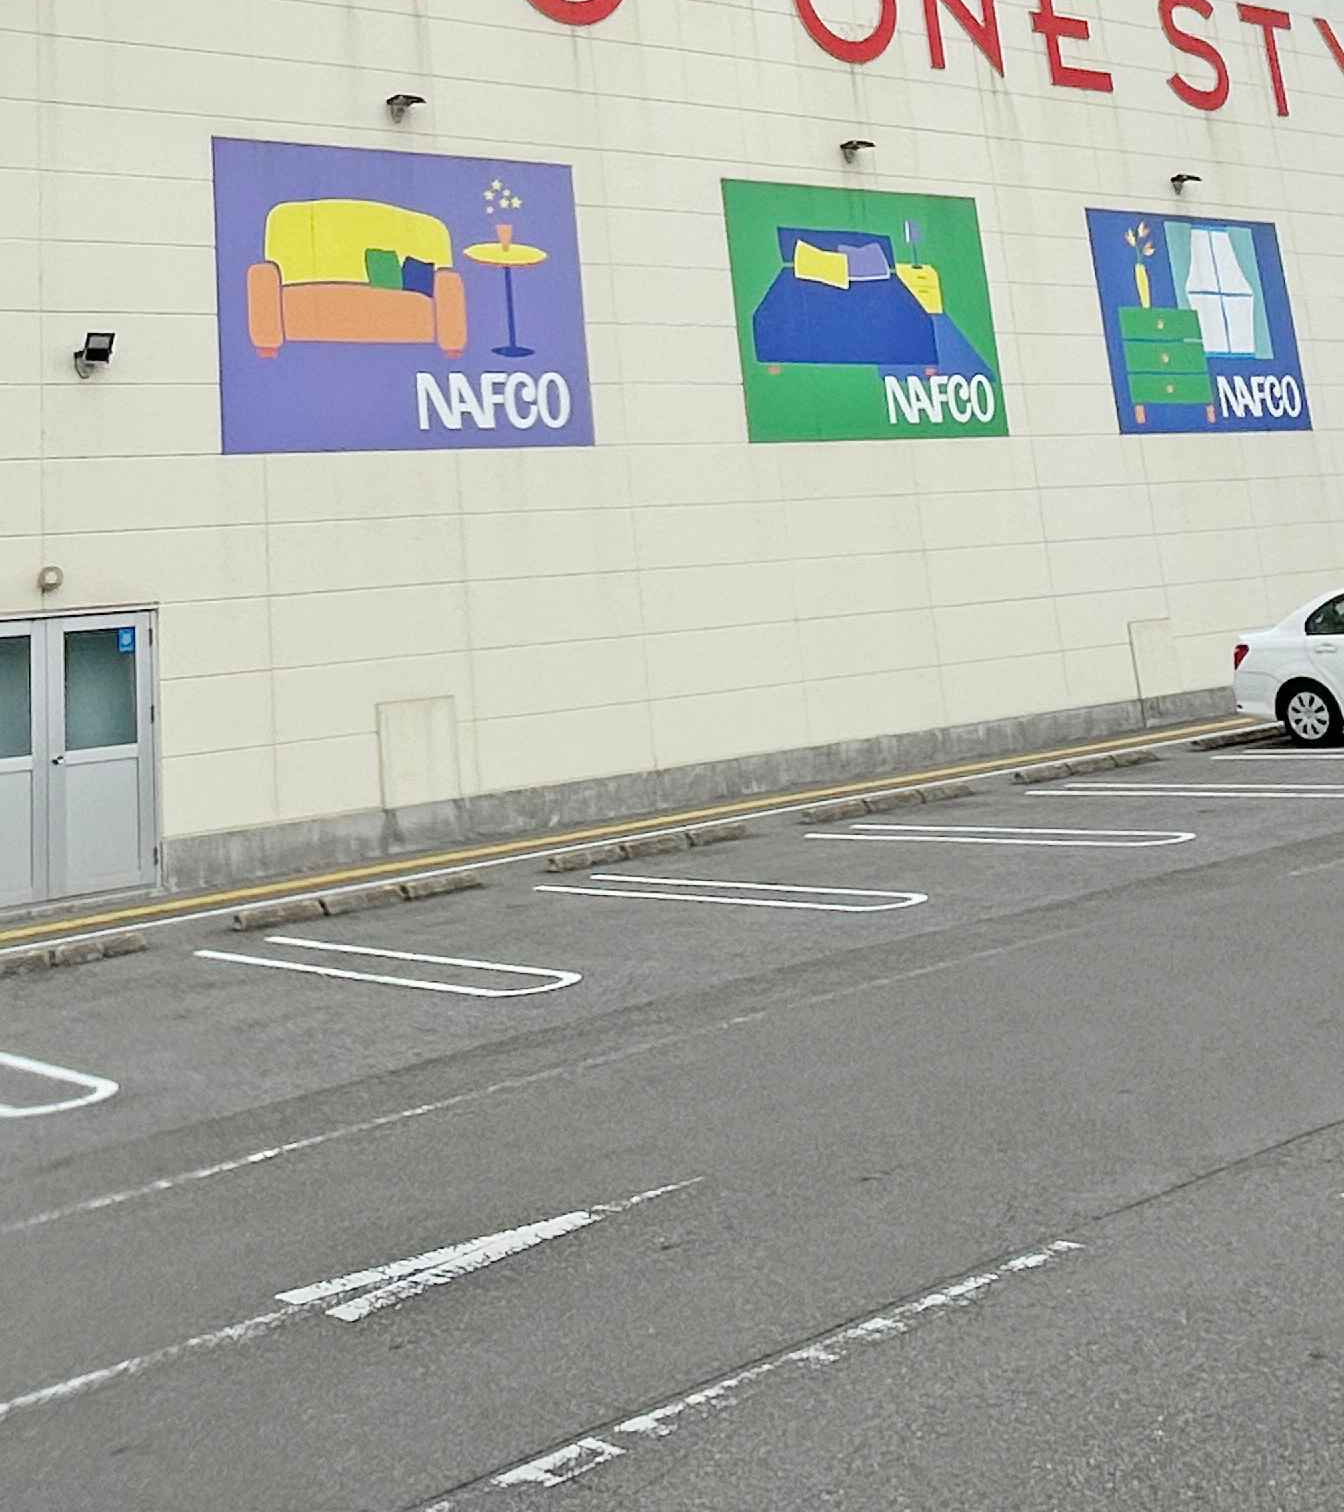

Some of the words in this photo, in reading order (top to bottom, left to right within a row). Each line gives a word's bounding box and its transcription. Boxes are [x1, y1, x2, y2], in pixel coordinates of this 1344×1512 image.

[415, 370, 571, 431] NAFCO
[883, 373, 995, 425] NAFCO
[1215, 374, 1302, 419] NAFCO
